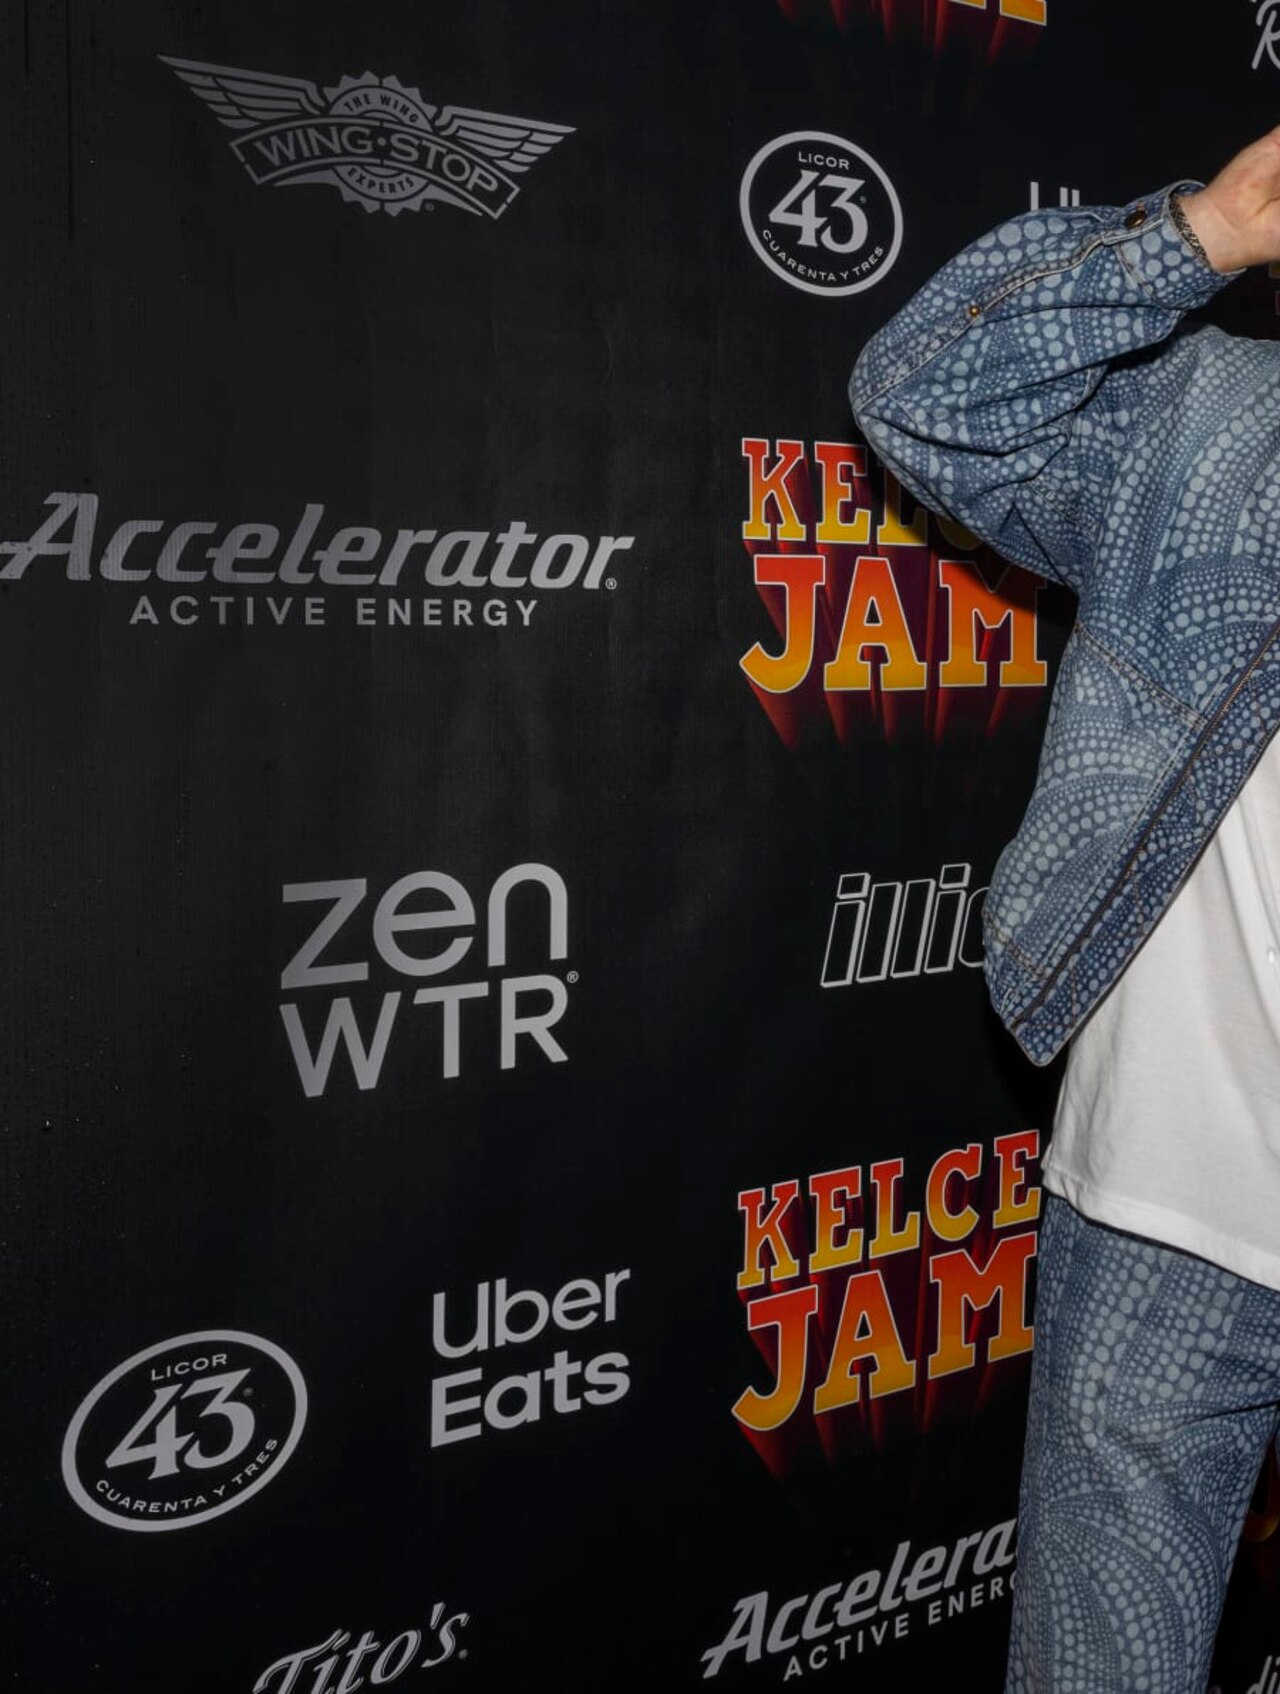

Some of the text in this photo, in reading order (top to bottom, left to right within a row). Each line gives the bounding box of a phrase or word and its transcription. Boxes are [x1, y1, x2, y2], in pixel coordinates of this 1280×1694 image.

[344, 94, 419, 124] THE WING
[346, 168, 415, 194] EXPERTS
[798, 151, 850, 171] LICOR
[762, 228, 885, 284] CUARENTA Y TRES
[768, 169, 868, 254] 43
[0, 492, 635, 590] Accelerator
[742, 437, 982, 551] KEL
[129, 596, 539, 628] ACTIVE ENERGY
[738, 553, 1048, 694] JAM
[280, 862, 569, 989] zen
[820, 862, 989, 988] illic
[279, 974, 569, 1098] WTR
[736, 1129, 1042, 1290] KELCE
[432, 1268, 631, 1359] Uber
[731, 1231, 1039, 1432] JAM
[150, 1353, 228, 1382] LICOR
[430, 1350, 631, 1449] Eats
[105, 1367, 256, 1480] 43
[95, 1437, 278, 1514] CUARENTA Y TRES
[252, 1601, 470, 1694] Tito's
[700, 1518, 1018, 1680] Accelera
[783, 1573, 1017, 1682] ACTIVE ENER
